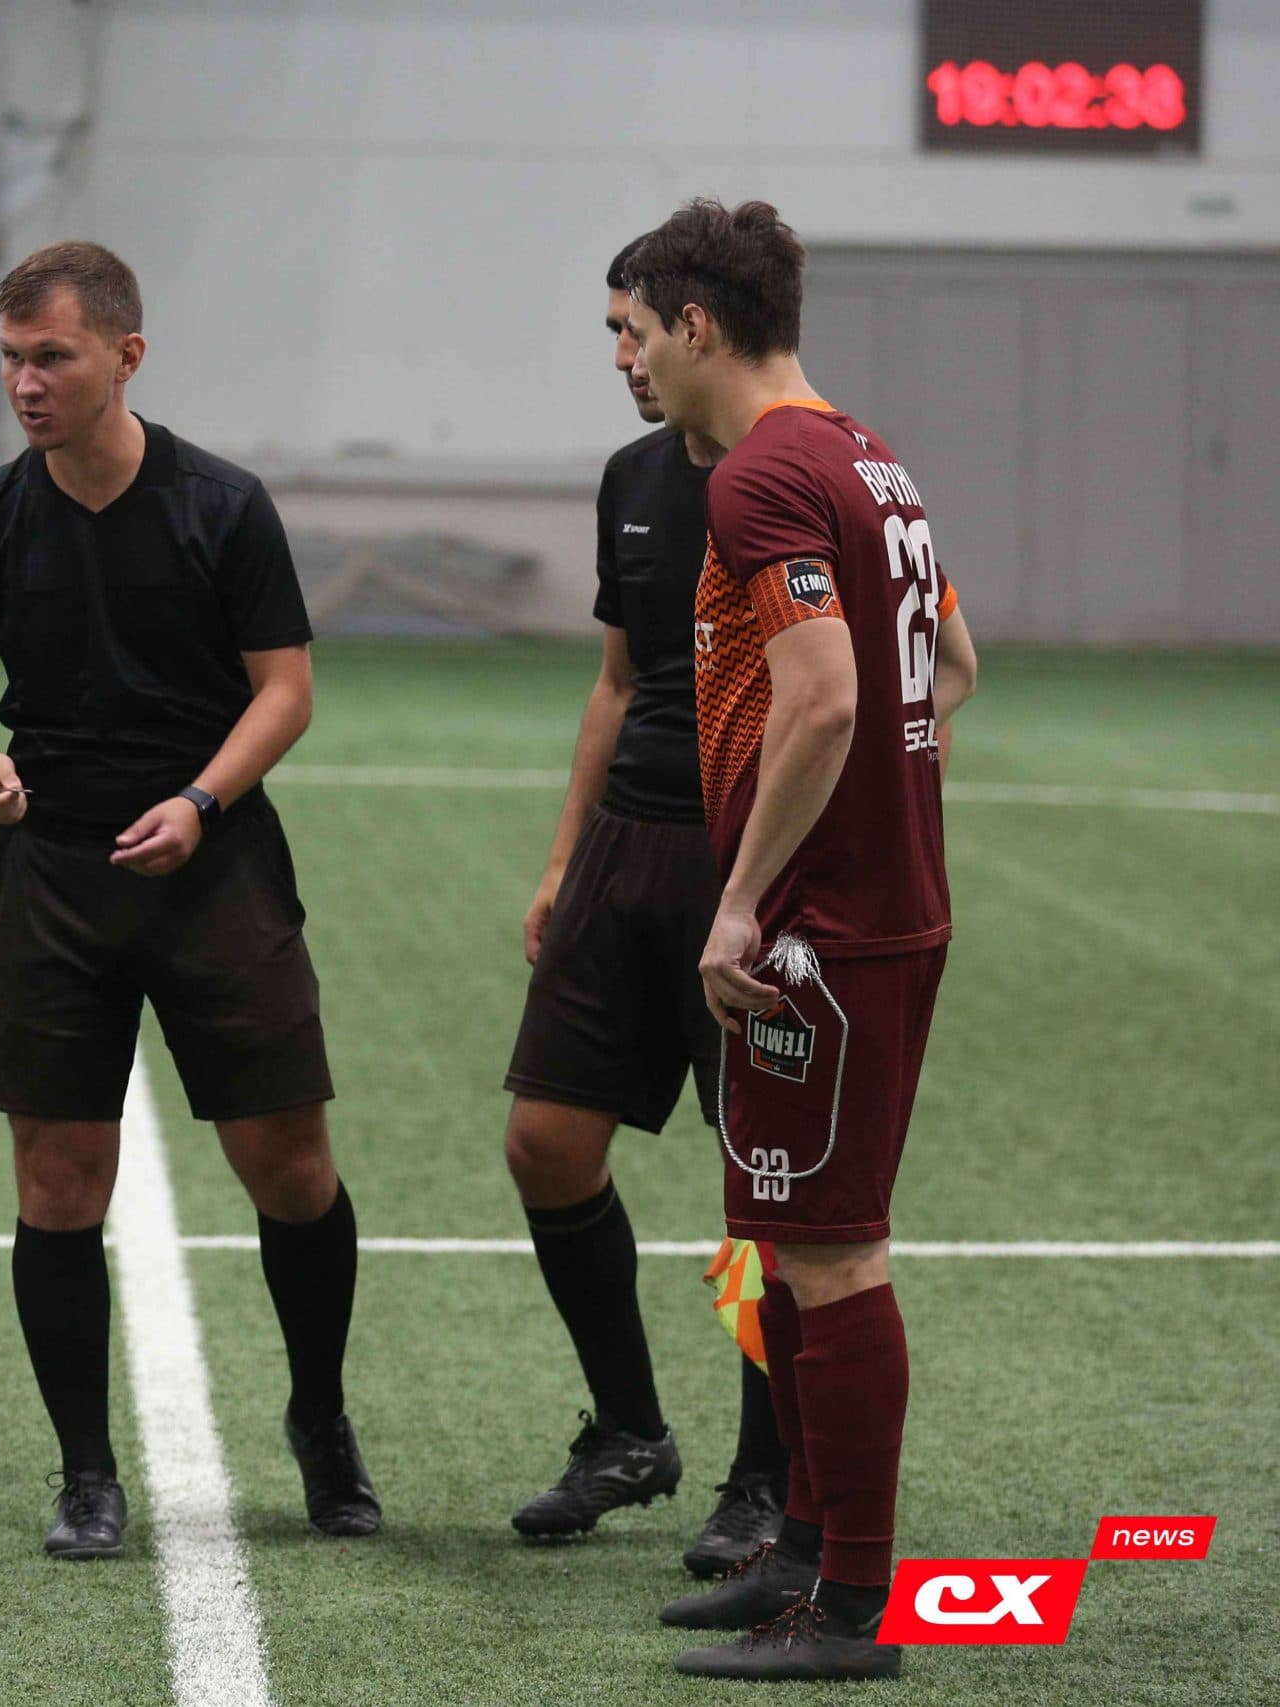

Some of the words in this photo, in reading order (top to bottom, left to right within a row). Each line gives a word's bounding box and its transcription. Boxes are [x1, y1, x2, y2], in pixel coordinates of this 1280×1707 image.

[790, 574, 831, 595] ТЕМП
[884, 514, 940, 705] 23
[751, 1147, 790, 1202] 23
